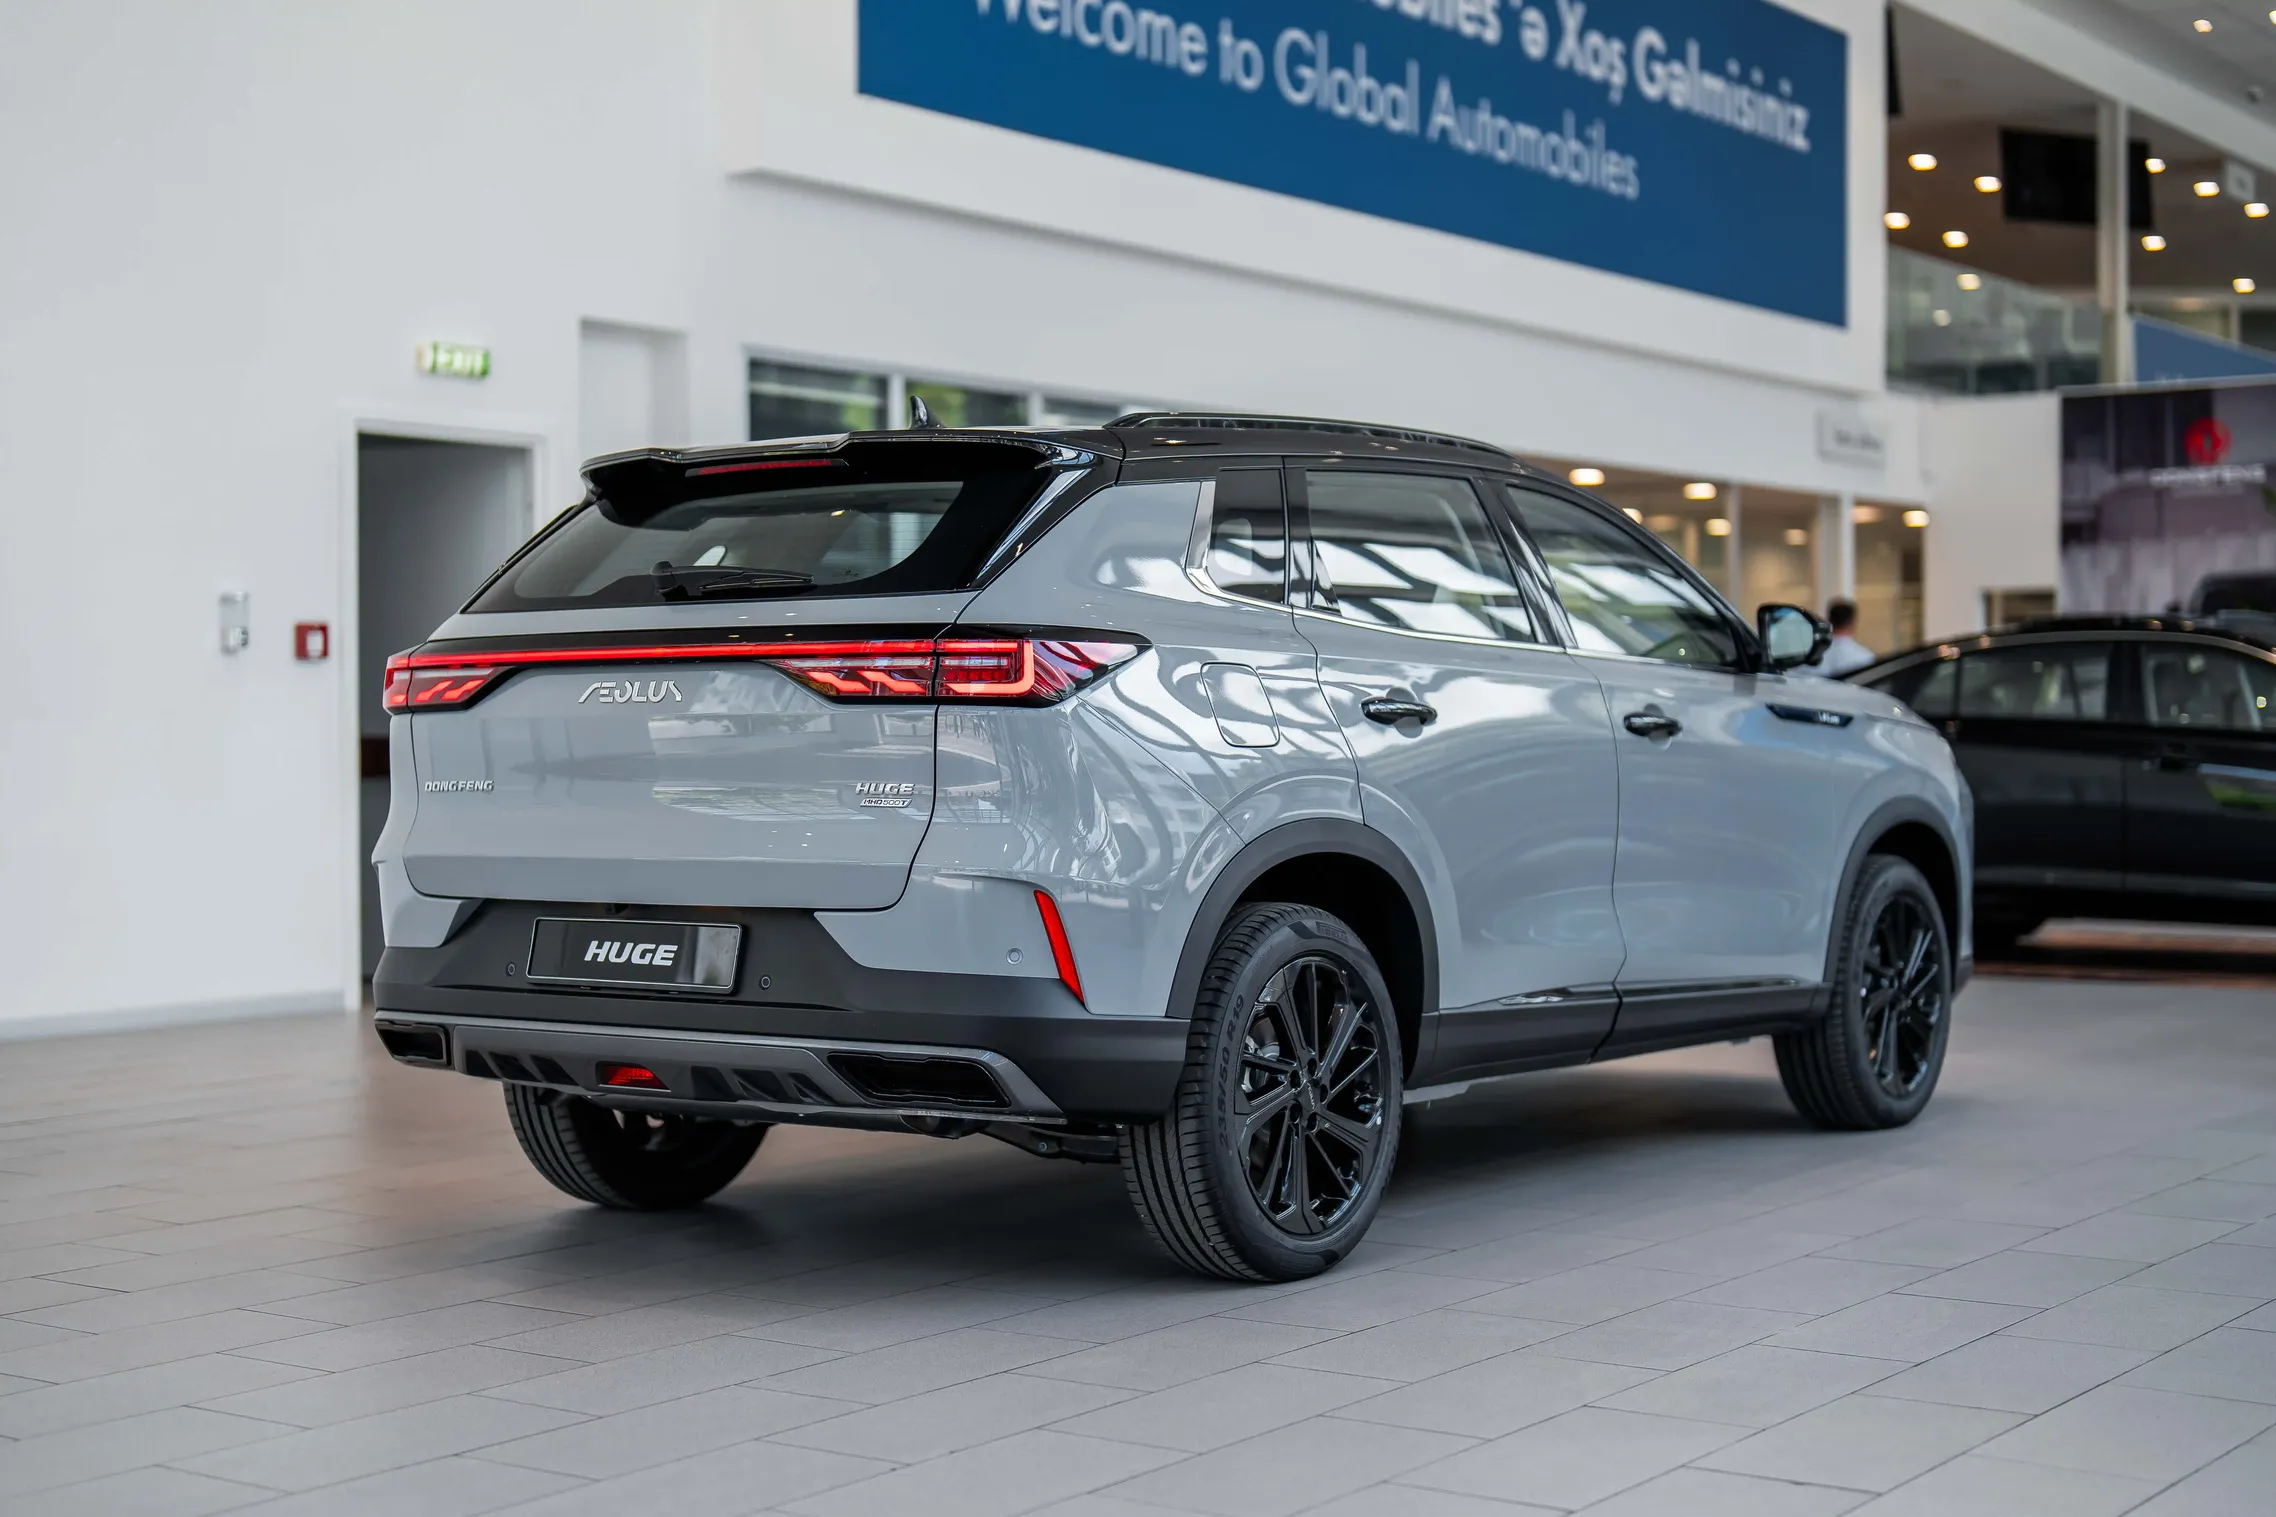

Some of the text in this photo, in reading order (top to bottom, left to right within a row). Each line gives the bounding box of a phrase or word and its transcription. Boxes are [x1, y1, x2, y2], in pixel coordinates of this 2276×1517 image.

[1217, 17, 1265, 92] to
[1274, 27, 1420, 137] Global
[1426, 73, 1640, 200] Automobiles
[855, 782, 915, 795] HUGE
[584, 940, 679, 967] HUGE
